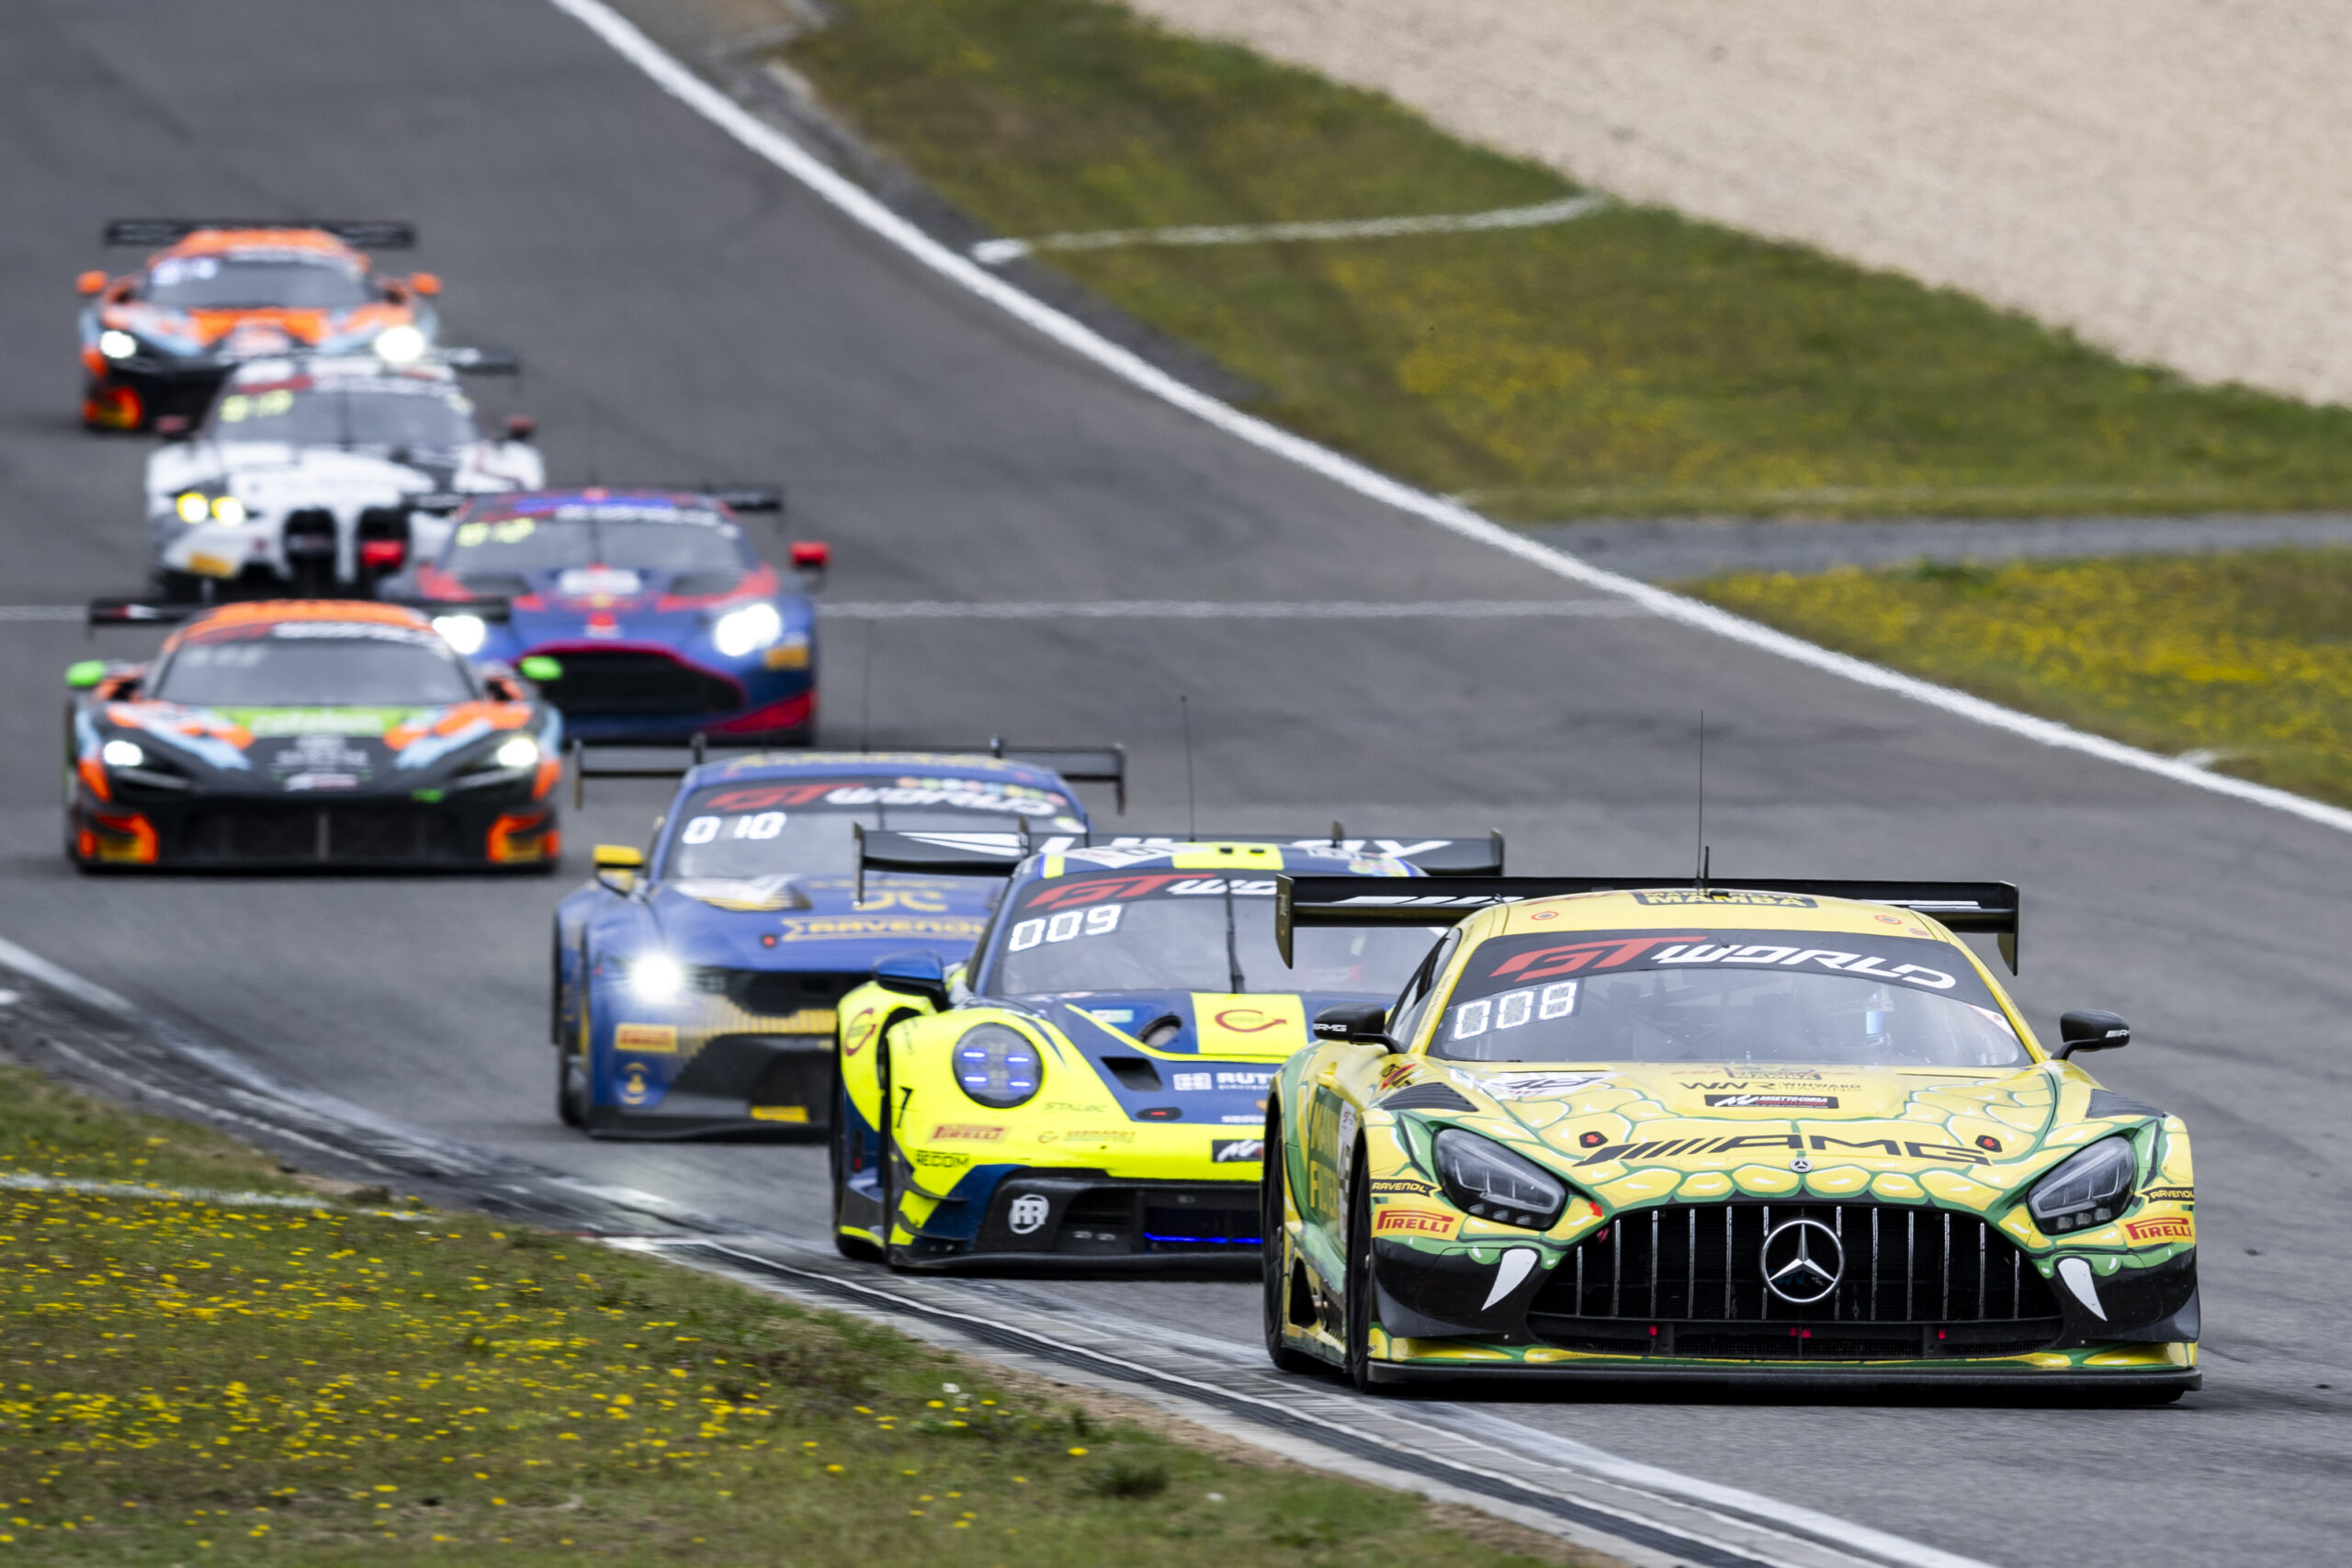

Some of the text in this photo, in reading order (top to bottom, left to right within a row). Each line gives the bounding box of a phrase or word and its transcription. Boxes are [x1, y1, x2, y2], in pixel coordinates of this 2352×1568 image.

[706, 783, 1057, 816] GT WORLD
[1024, 874, 1217, 909] GT
[1646, 896, 1807, 906] MAMBA
[1009, 903, 1123, 952] 009
[1488, 936, 1957, 989] GT WORLD
[1452, 980, 1577, 1042] 008
[1707, 1134, 1992, 1167] AMG
[1372, 1182, 1428, 1193] RAVENOL
[1376, 1210, 1454, 1234] PIRELLI
[2125, 1217, 2192, 1241] PIRELLI
